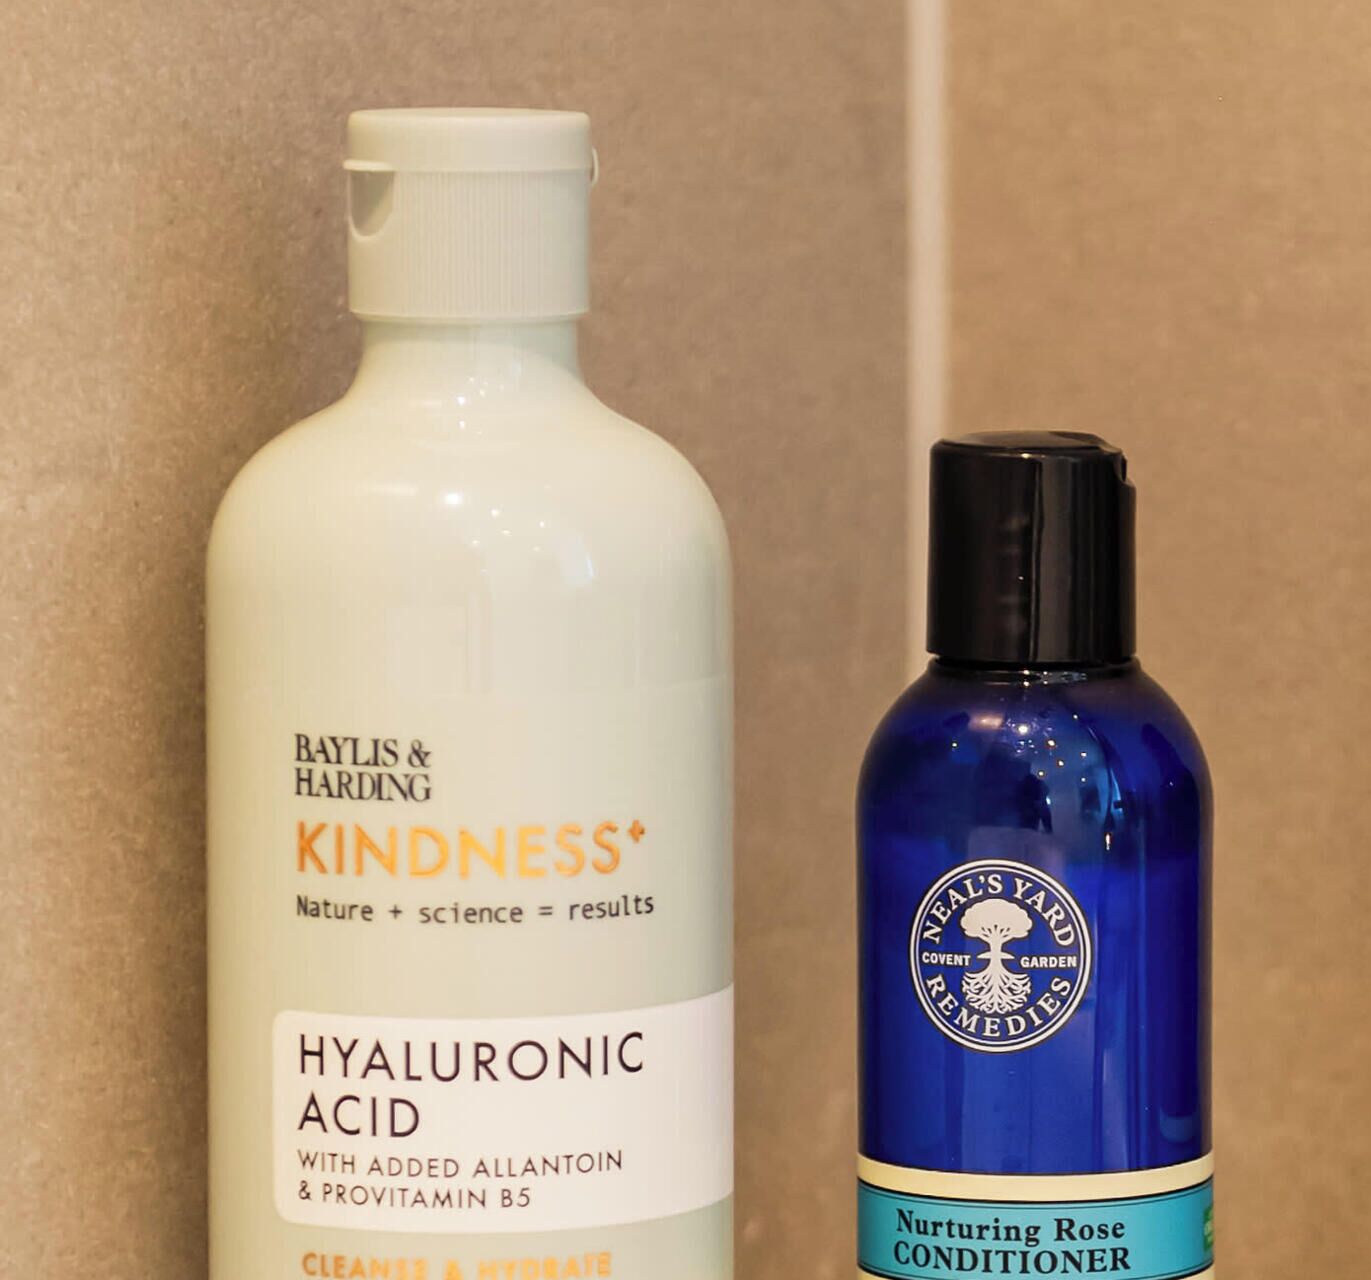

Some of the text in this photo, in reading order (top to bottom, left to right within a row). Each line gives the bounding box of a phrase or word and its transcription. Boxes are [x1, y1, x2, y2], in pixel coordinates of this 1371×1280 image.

[294, 734, 431, 768] BAYLIS &
[294, 768, 431, 802] HARDING
[297, 894, 654, 924] Nature science results
[923, 874, 1076, 946] NEAL'S YARD
[922, 952, 1077, 968] COVENT GARDEN
[927, 974, 1071, 1037] REMEDIES
[300, 1032, 644, 1082] HYALURONIC
[298, 1092, 419, 1137] ACID
[298, 1150, 622, 1178] WITH ADDED ALLANTOIN
[298, 1182, 531, 1208] & PROVITAMIN B5
[896, 1208, 1125, 1246] Nurturing Rose
[894, 1241, 1131, 1274] CONDITIONER
